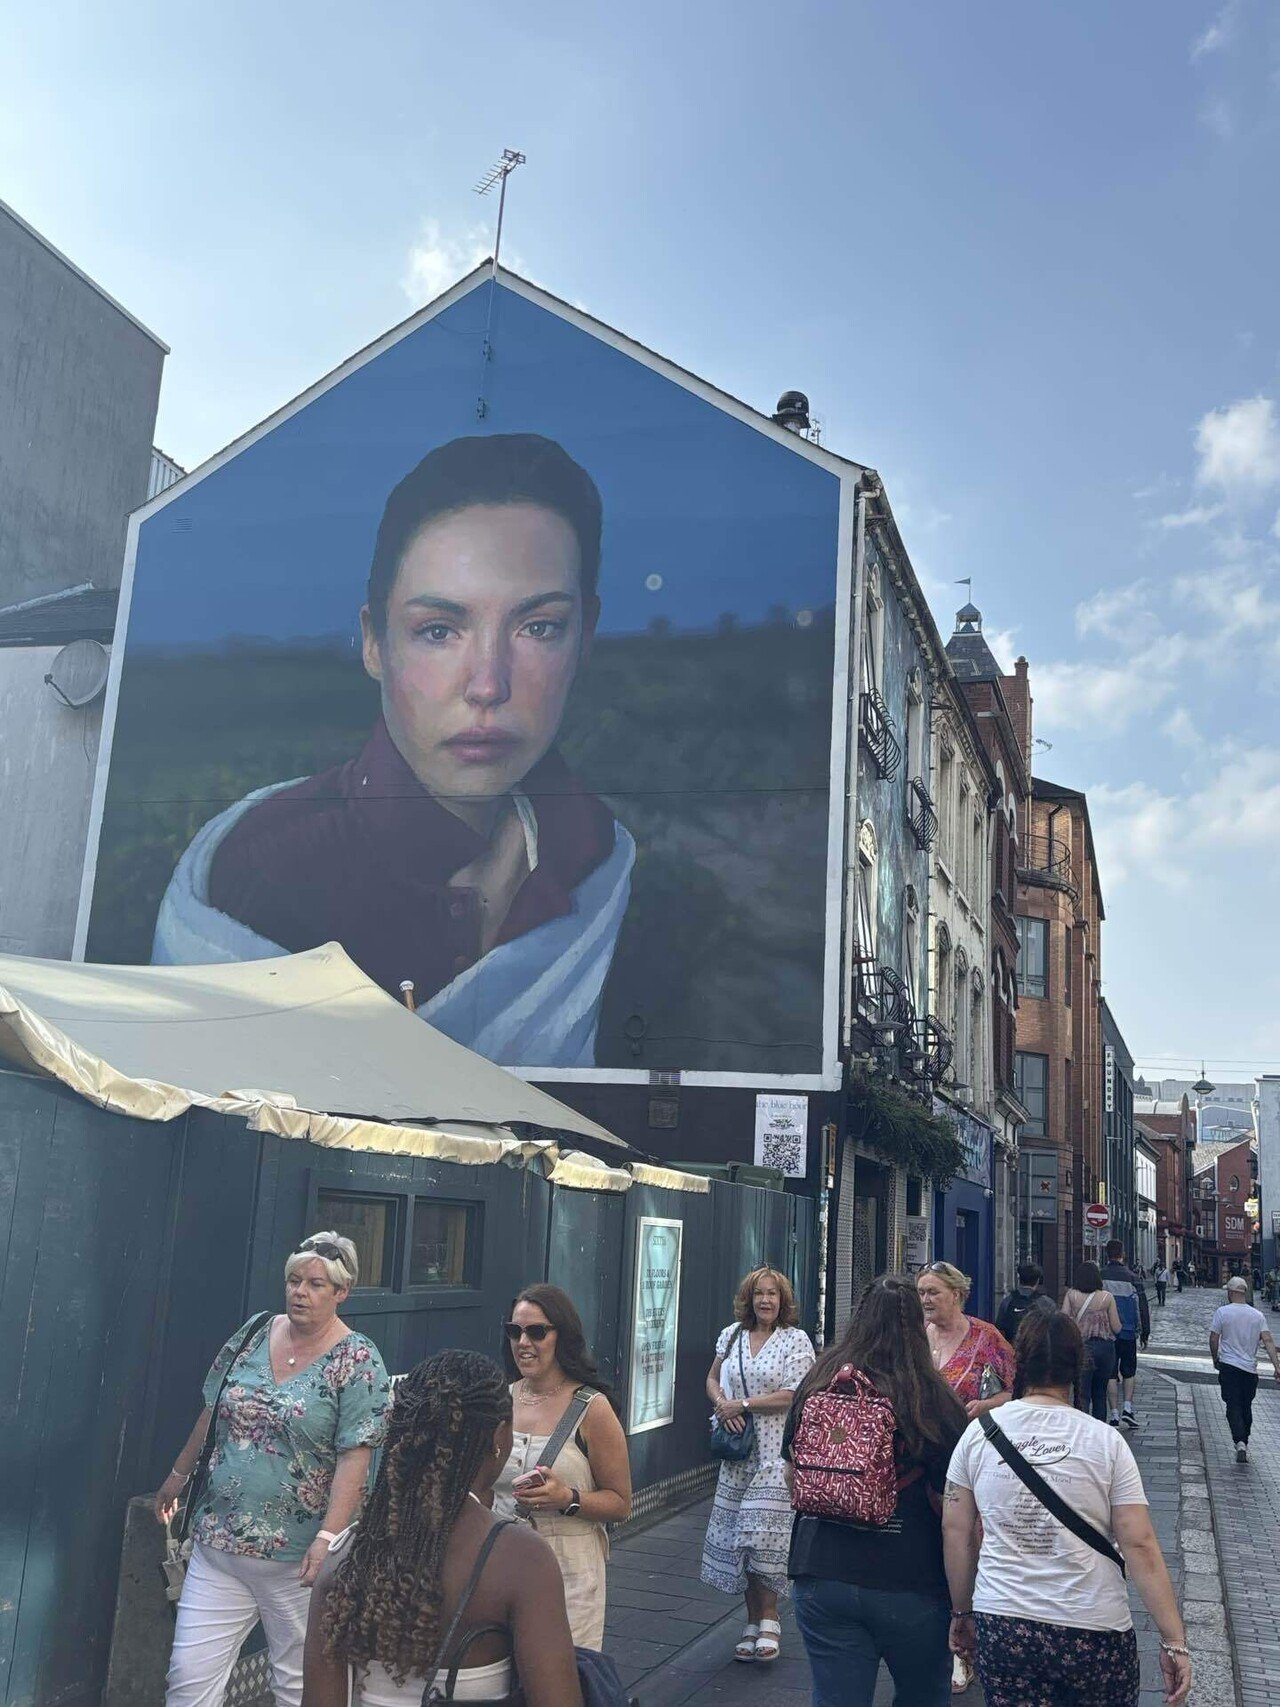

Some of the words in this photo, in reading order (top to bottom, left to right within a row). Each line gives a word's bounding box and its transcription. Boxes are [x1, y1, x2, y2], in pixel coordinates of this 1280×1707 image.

[1225, 1216, 1245, 1230] SDM
[1011, 1435, 1039, 1452] ggie
[1030, 1443, 1066, 1457] Lover
